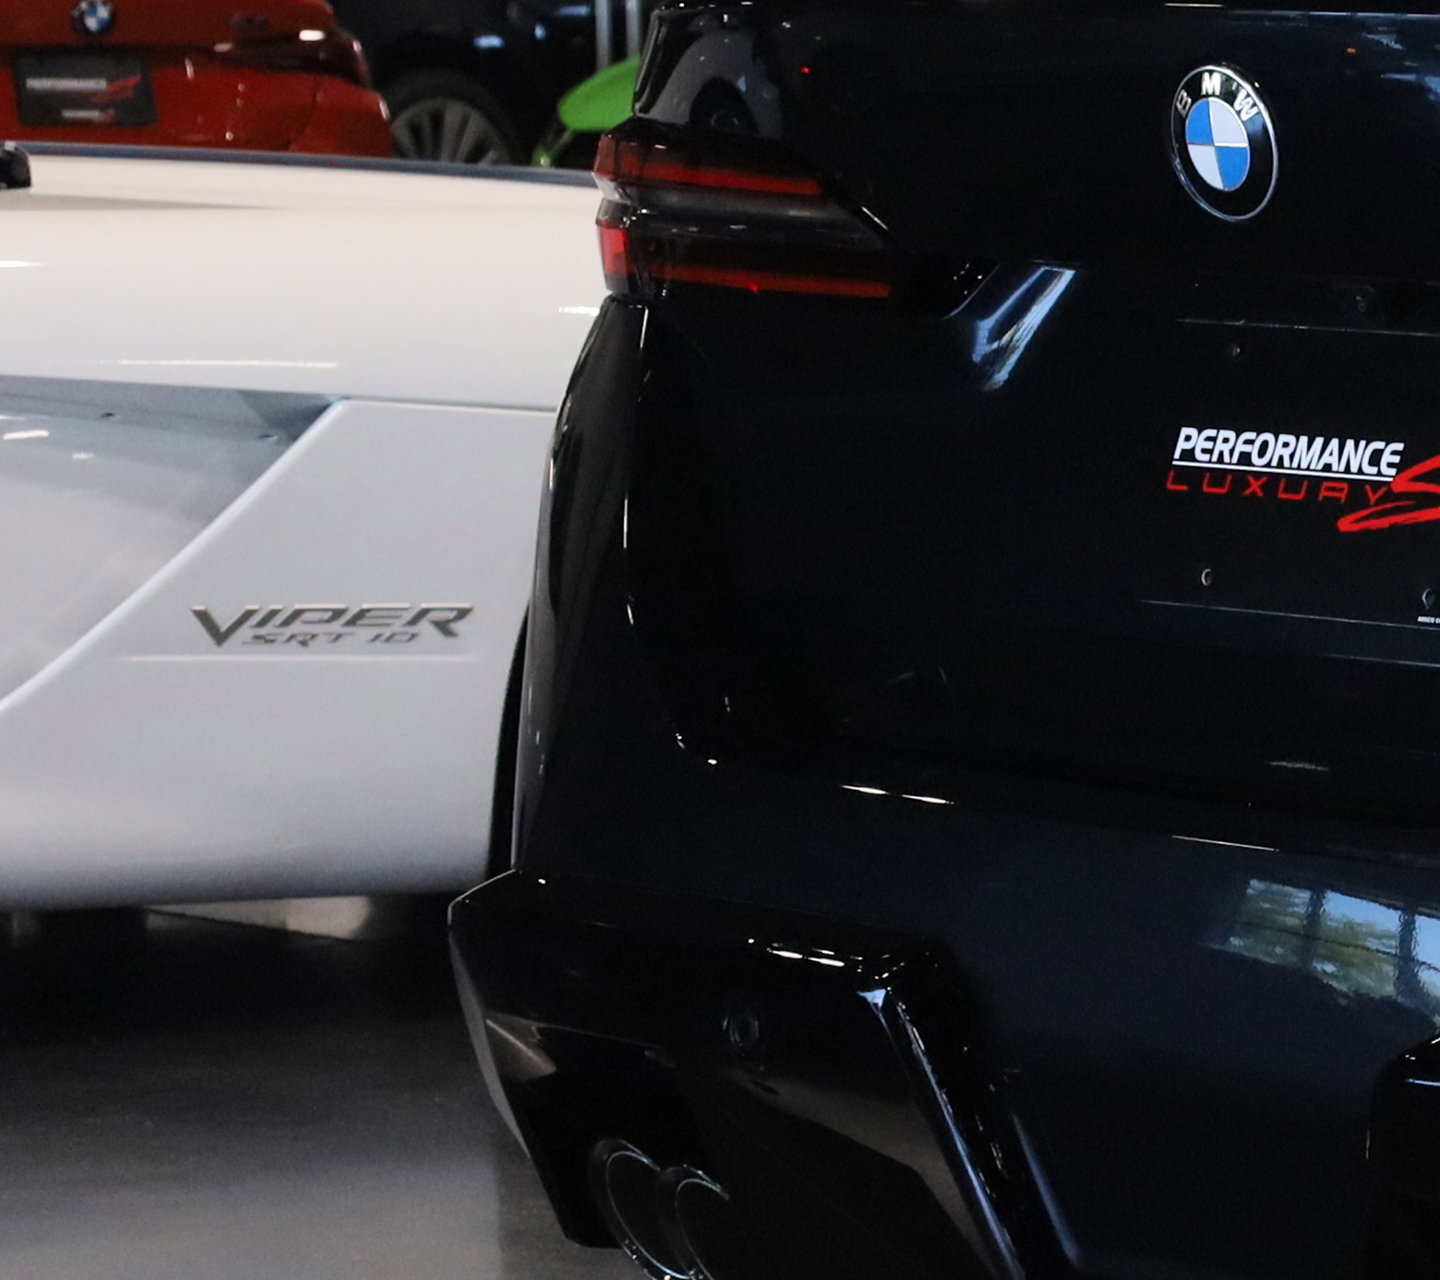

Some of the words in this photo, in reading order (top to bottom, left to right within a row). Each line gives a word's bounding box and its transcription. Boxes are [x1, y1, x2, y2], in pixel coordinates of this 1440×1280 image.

[1176, 72, 1258, 121] BMW
[1173, 426, 1404, 477] PERFORMANCE
[1166, 470, 1388, 505] LUXURY
[191, 603, 473, 647] VIPER
[241, 632, 353, 647] SRT
